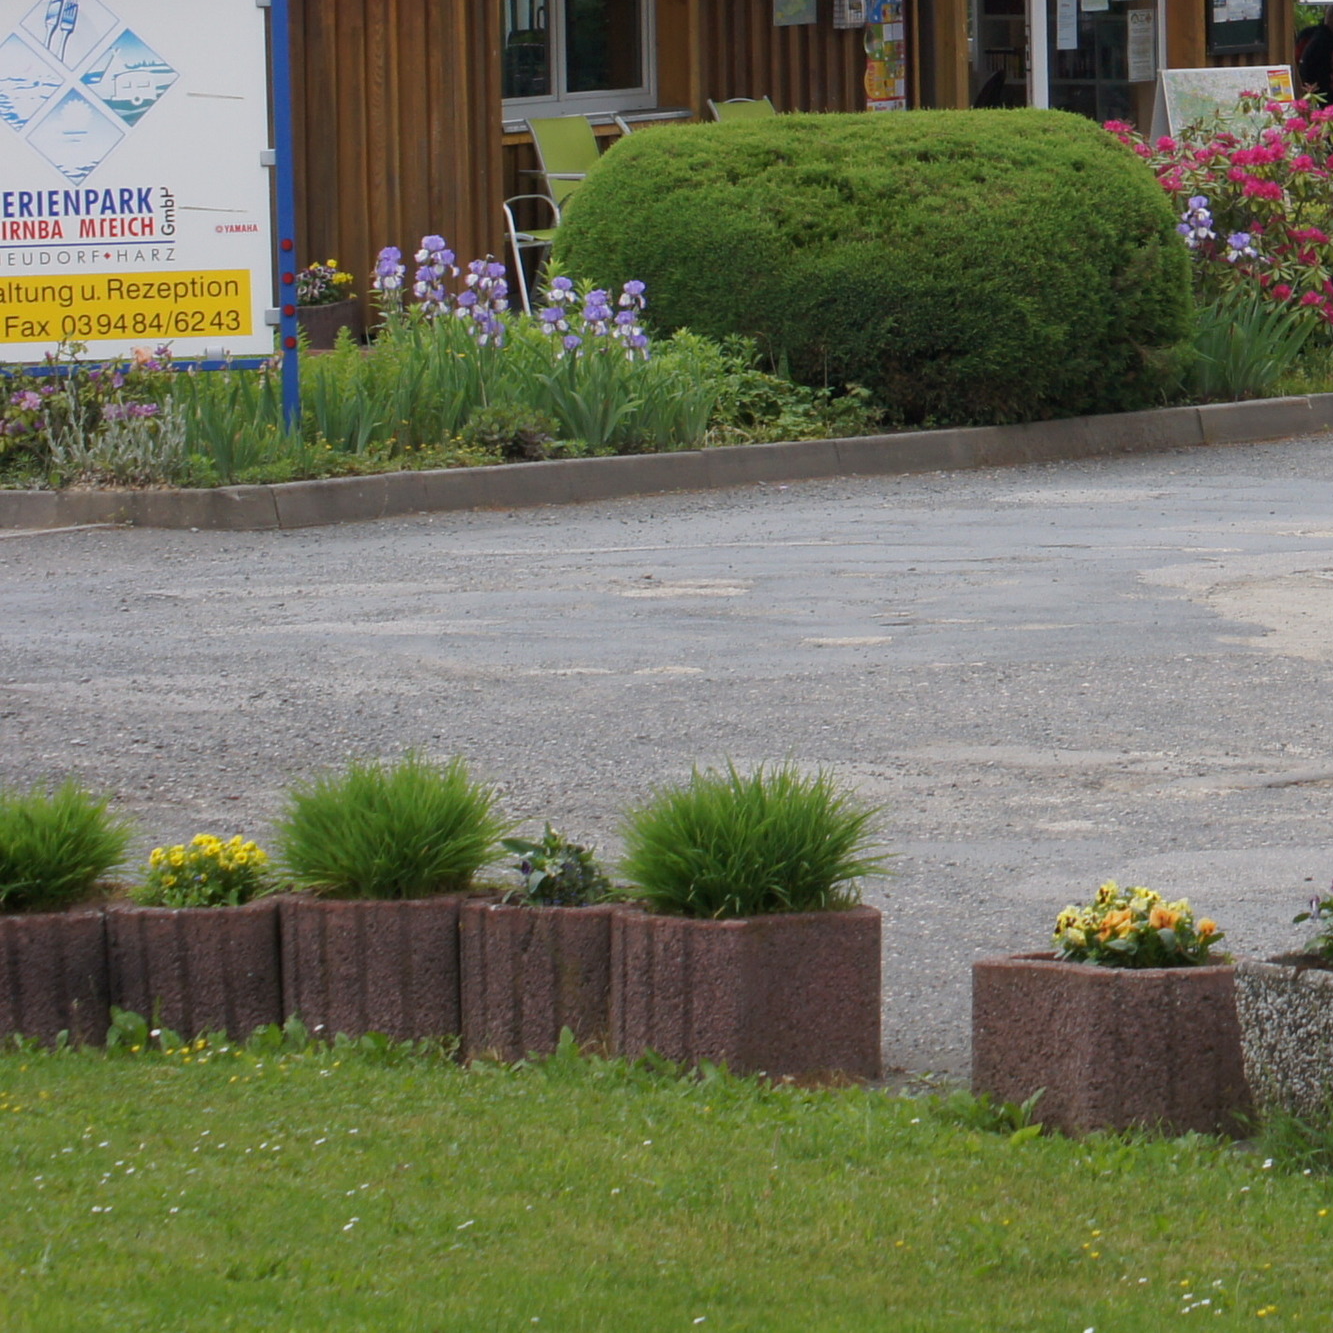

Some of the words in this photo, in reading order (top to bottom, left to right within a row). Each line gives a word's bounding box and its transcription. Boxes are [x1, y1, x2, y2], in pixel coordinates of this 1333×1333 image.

[160, 187, 175, 236] GmbH
[225, 223, 258, 233] YAMAHA
[117, 247, 175, 263] HARZ
[82, 285, 101, 301] u.
[107, 276, 239, 304] Rezeption
[5, 317, 50, 337] Fax
